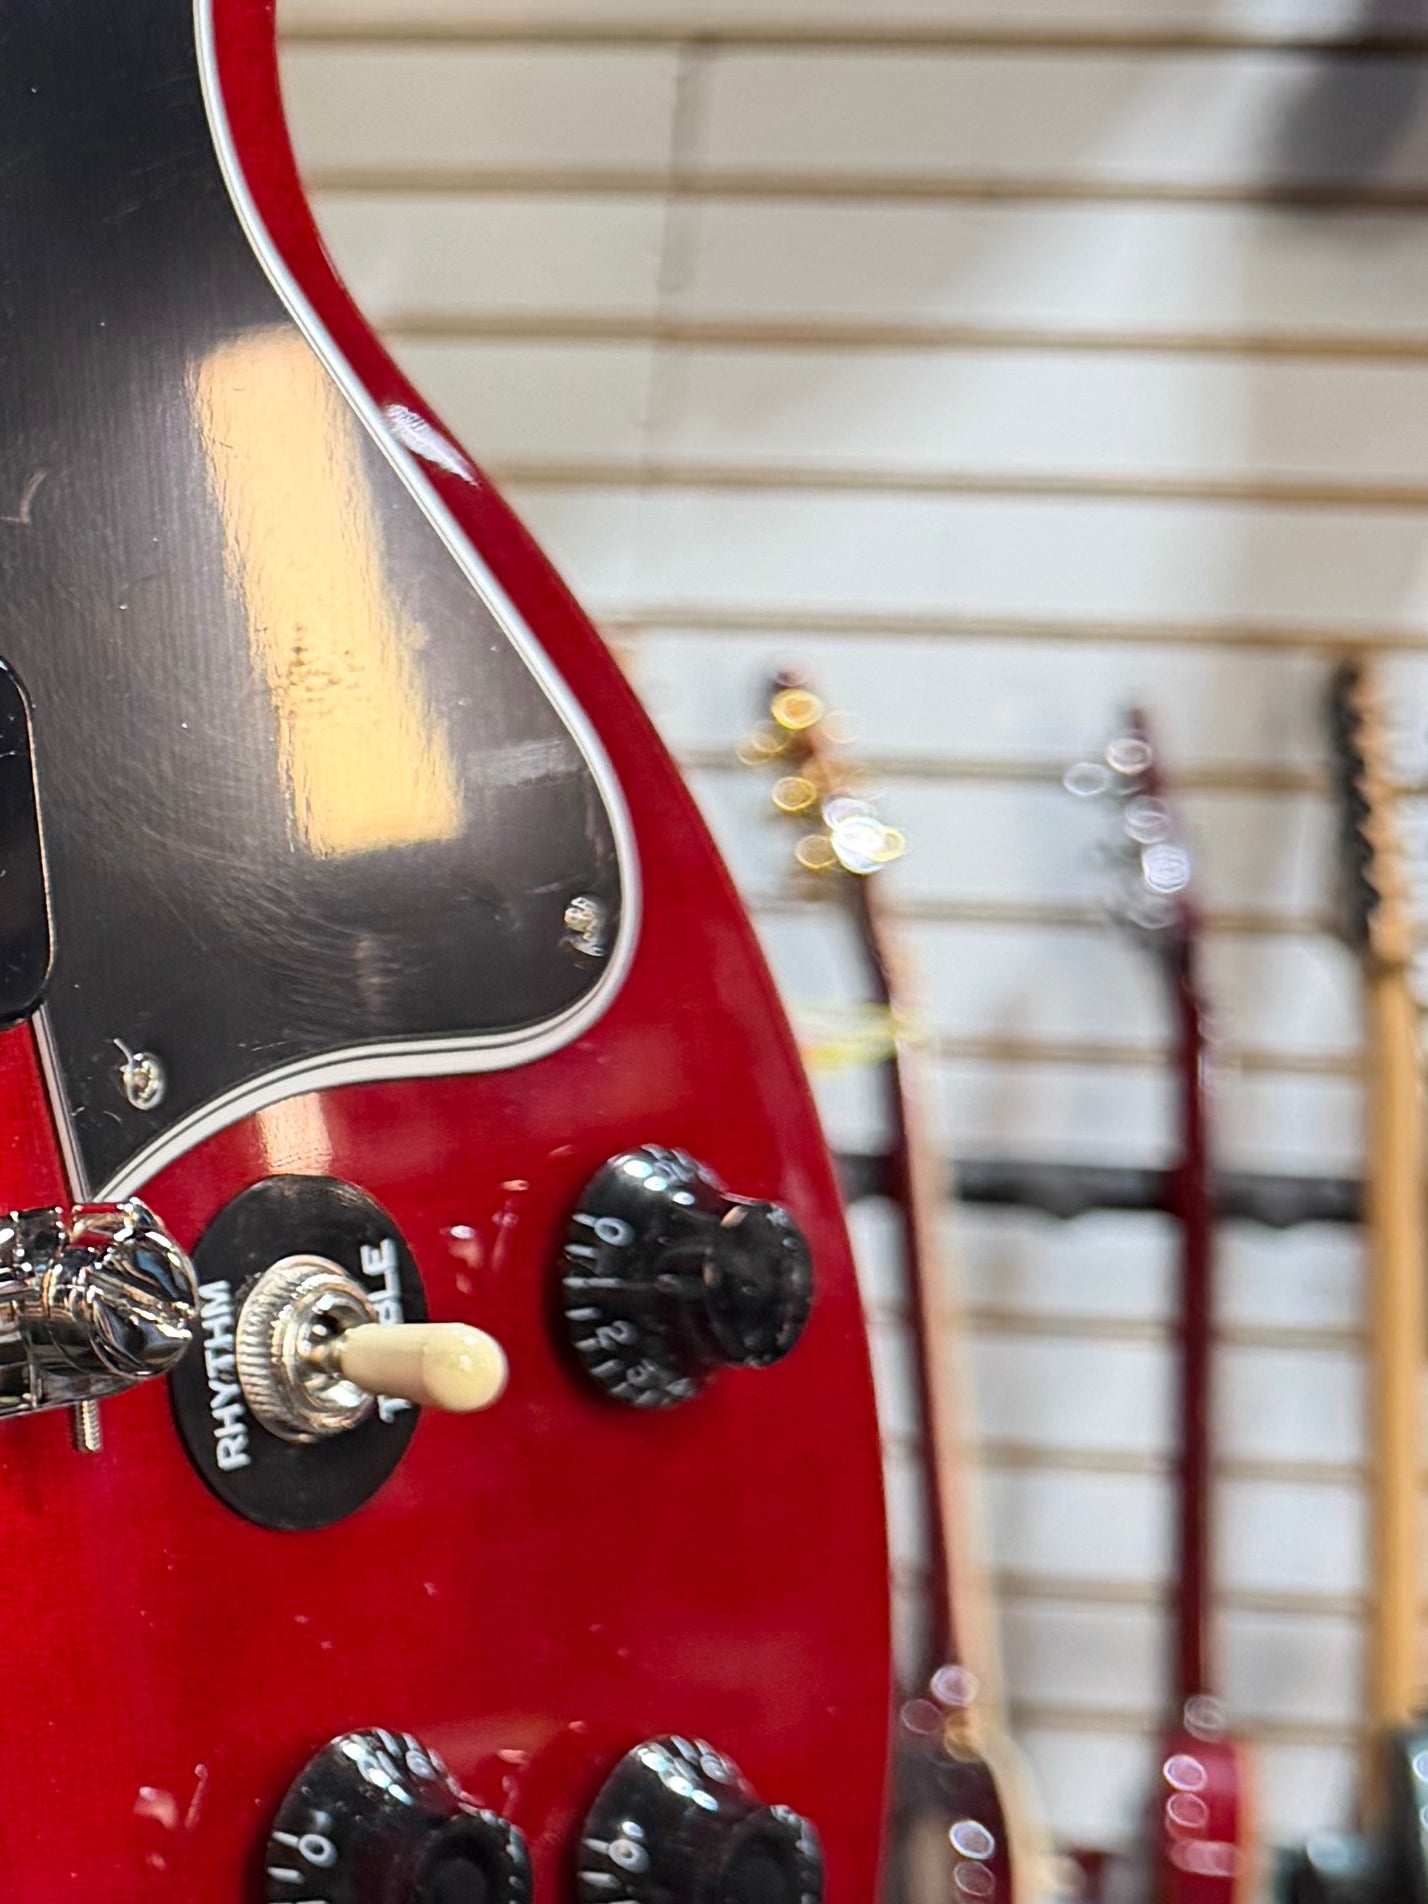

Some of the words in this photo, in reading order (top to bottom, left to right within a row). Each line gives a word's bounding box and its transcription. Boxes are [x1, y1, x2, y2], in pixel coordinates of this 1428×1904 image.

[199, 1280, 251, 1471] RHYTHM
[298, 1833, 338, 1868] 0
[608, 1839, 650, 1873] 0
